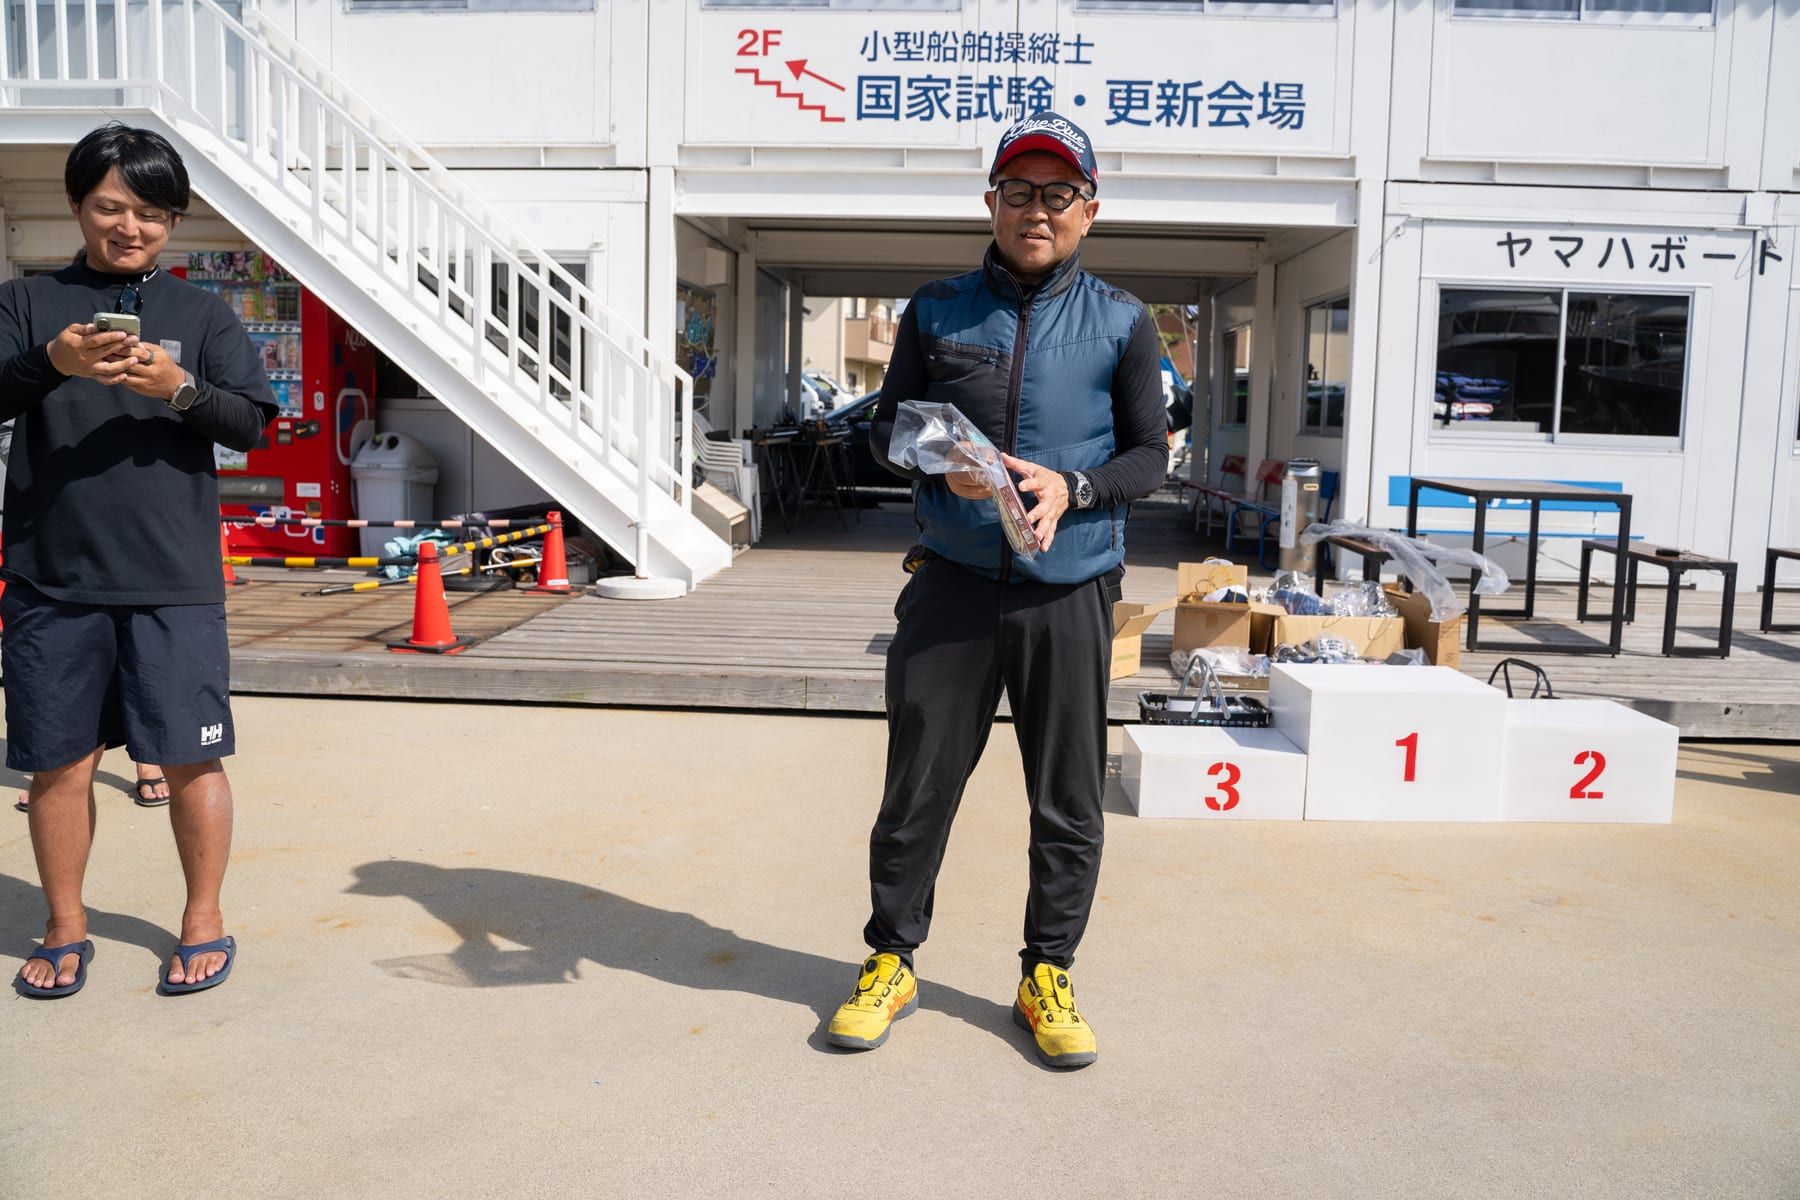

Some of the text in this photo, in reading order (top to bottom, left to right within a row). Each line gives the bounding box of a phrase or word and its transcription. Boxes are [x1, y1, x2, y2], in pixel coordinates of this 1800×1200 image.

[736, 29, 783, 57] 2F
[860, 30, 1096, 66] 小型船舶操縦士
[1496, 231, 1783, 276] ヤマハボート
[201, 723, 223, 742] HH
[1395, 732, 1419, 783] 1
[1569, 750, 1607, 800] 2
[1204, 761, 1242, 812] 3
